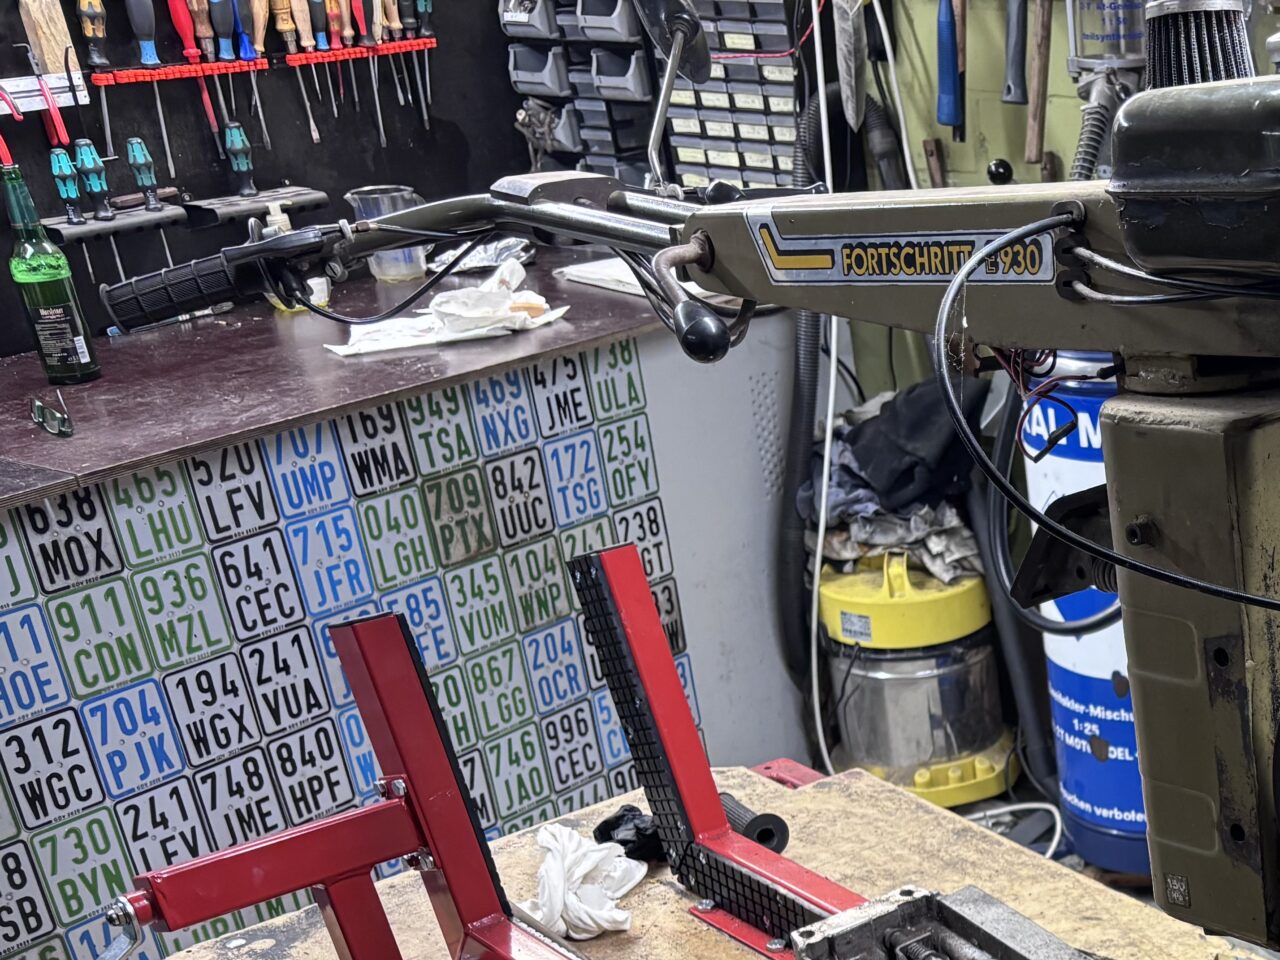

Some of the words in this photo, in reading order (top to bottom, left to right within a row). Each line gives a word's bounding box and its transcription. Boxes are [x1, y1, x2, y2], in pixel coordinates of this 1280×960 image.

[841, 241, 975, 277] FORTSCHRITT
[546, 387, 587, 431] JME
[597, 371, 640, 413] ULA
[418, 423, 472, 468] TSA
[482, 405, 530, 451] NXG
[603, 420, 646, 464] 254
[281, 460, 336, 511] UMP
[351, 442, 410, 490] WMA
[491, 456, 540, 500] 842
[551, 440, 596, 483] 172
[612, 456, 649, 500] OFY
[206, 481, 265, 534] LFV
[364, 494, 419, 541] 040
[426, 473, 481, 521] 709
[500, 496, 547, 541] UUC
[557, 477, 601, 520] TSG
[126, 504, 192, 559] LHU
[292, 514, 353, 566] 715
[439, 512, 491, 561] PTX
[39, 528, 113, 585] MOX
[219, 537, 282, 588] 641
[376, 535, 430, 583] LGH
[510, 543, 557, 587] 104
[641, 542, 665, 578] GT
[141, 563, 208, 616] 936
[236, 582, 295, 632] CEC
[314, 559, 365, 608] JFR
[450, 562, 500, 608] 345
[519, 582, 561, 626] WNP
[55, 587, 125, 642] 911
[155, 610, 223, 662] MZL
[459, 601, 510, 647] VUM
[74, 633, 143, 688] CDN
[249, 633, 309, 686] 241
[415, 625, 450, 667] FE
[528, 625, 573, 672] 204
[175, 662, 239, 714] 194
[470, 648, 515, 695] 867
[538, 663, 582, 707] OCR
[89, 688, 161, 746] 704
[261, 678, 323, 726] VUA
[482, 686, 527, 732] LGG
[5, 718, 80, 774] 312
[186, 704, 254, 759] WGX
[276, 727, 335, 778] 840
[545, 707, 589, 750] 996
[106, 732, 175, 790] PJK
[489, 730, 537, 778] 746
[555, 742, 597, 786] CEC
[19, 764, 93, 821] WGC
[200, 757, 265, 811] 748
[289, 766, 340, 819] HPF
[505, 767, 544, 811] JAO
[123, 786, 189, 843] 241
[224, 796, 279, 847] JME
[38, 818, 111, 877] 730
[57, 859, 127, 918] BYN
